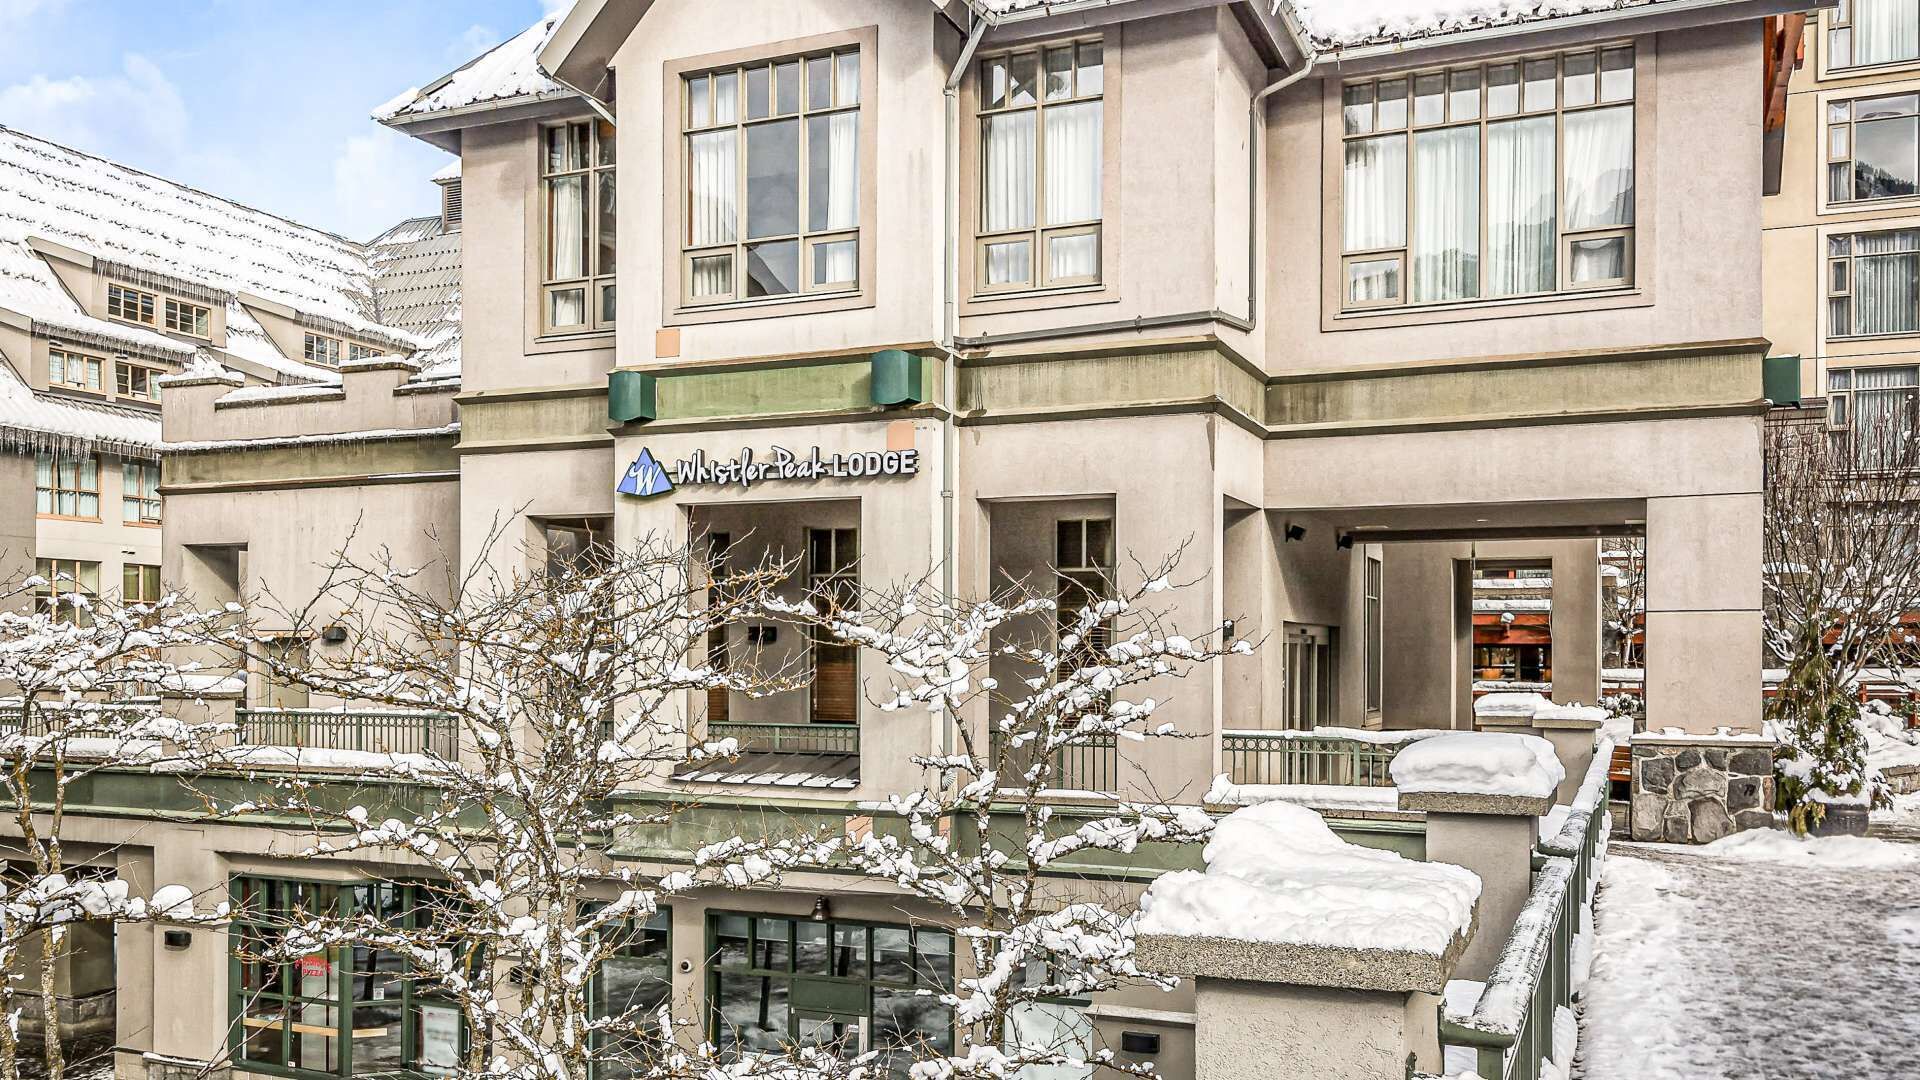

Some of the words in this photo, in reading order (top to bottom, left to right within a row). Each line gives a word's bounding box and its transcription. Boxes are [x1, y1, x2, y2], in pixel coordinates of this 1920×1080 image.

[629, 464, 661, 495] W
[677, 447, 770, 486] Whistler
[771, 445, 827, 480] Peak
[833, 449, 917, 477] LODGE
